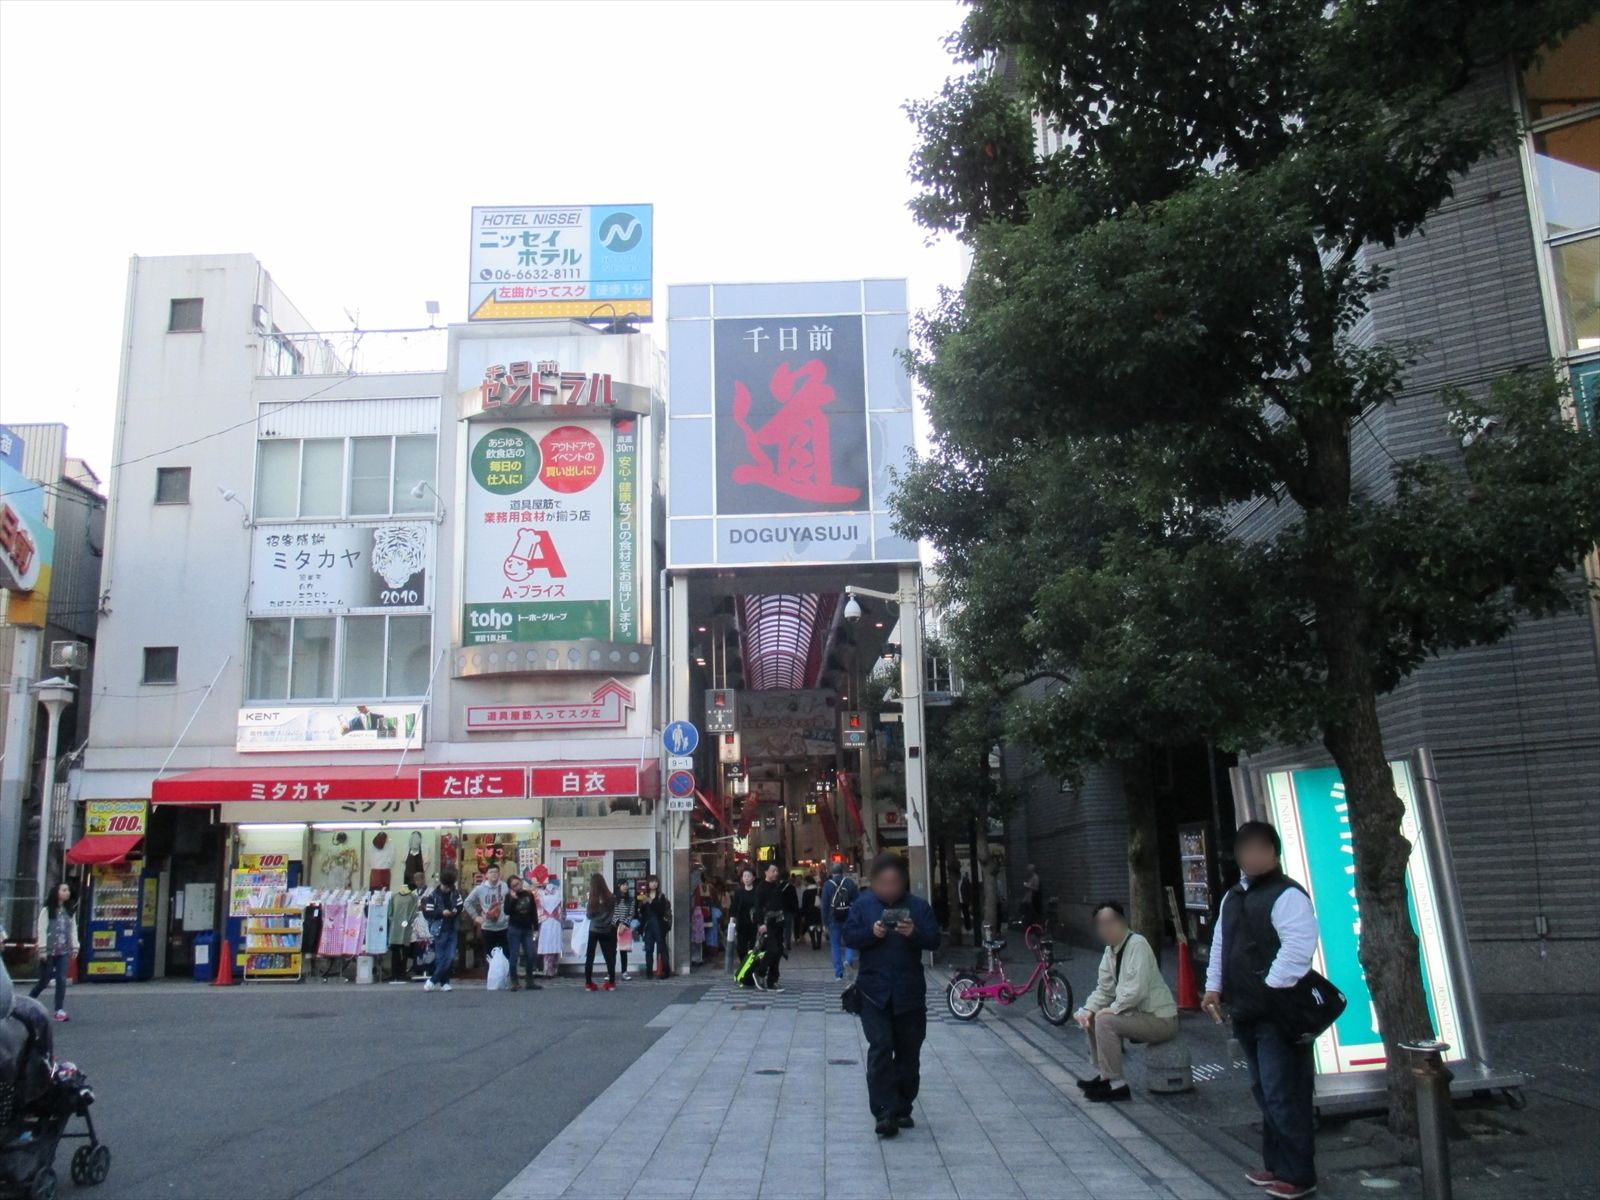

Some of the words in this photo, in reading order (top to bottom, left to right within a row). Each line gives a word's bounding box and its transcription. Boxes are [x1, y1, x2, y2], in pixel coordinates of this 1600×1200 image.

[481, 213, 529, 226] HOTEL
[533, 213, 581, 225] NISSEI
[480, 230, 561, 248] ニッセイ
[517, 248, 583, 267] ホテル
[495, 268, 581, 280] 06-6632-8111
[499, 285, 587, 299] 左曲がってスグ
[742, 324, 834, 353] 千日前
[480, 371, 618, 410] セントラル
[732, 358, 862, 504] 道
[488, 437, 523, 447] あらゆる
[550, 441, 596, 451] アウトドアや
[615, 444, 634, 453] 30m
[486, 449, 525, 459] 飲食店の
[551, 453, 595, 462] イベントの
[489, 460, 522, 472] 毎日の
[546, 465, 596, 477] 買い出しに!
[487, 474, 523, 486] 仕入に!
[509, 499, 562, 510] 道具屋筋で
[484, 510, 591, 523] 業務用食材が揃う店
[729, 525, 859, 545] DOGUYASUJI
[273, 549, 361, 570] ミタカヤ
[380, 590, 419, 605] 2010
[502, 584, 566, 599] A-プライス
[469, 608, 513, 630] toho
[518, 612, 568, 622] トーホーグループ
[246, 712, 280, 721] KENT
[487, 709, 601, 722] 道具屋筋入ってスグ左
[443, 774, 504, 796] たばこ
[561, 771, 607, 793] 白衣
[251, 782, 330, 800] ミタカヤ
